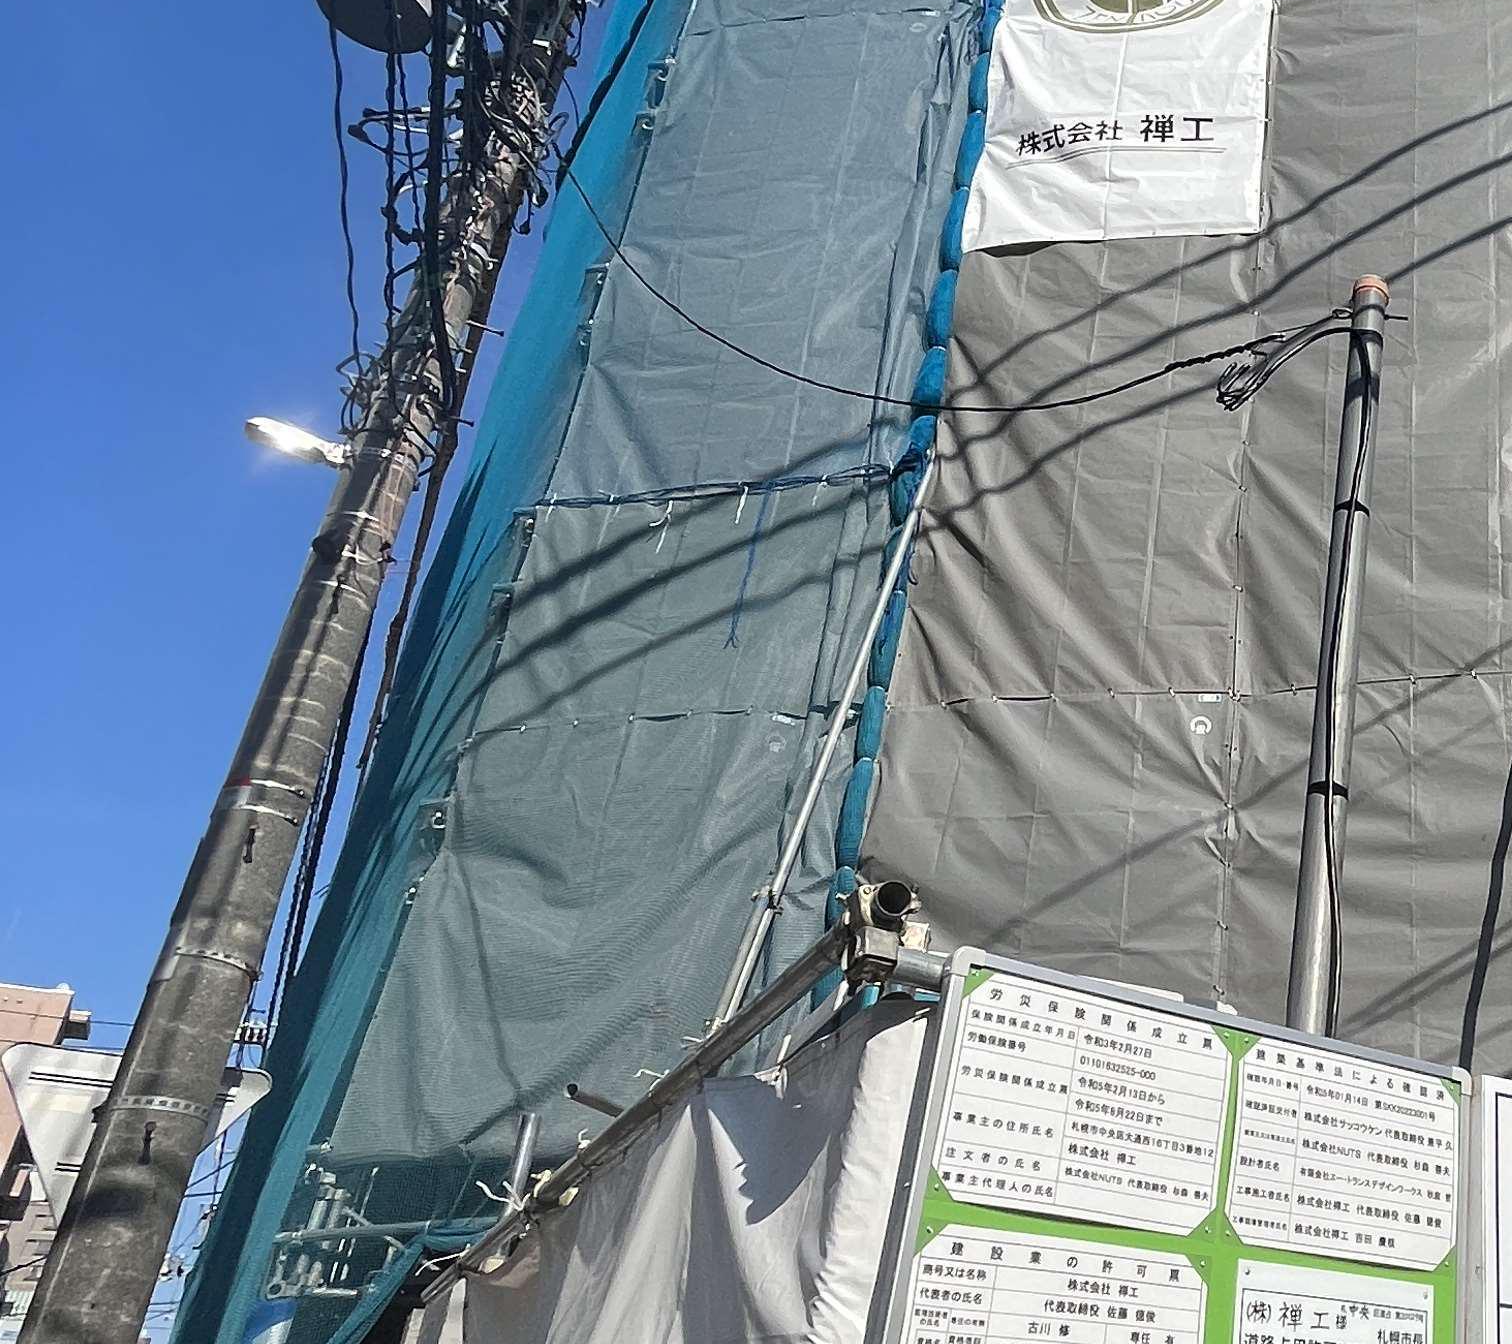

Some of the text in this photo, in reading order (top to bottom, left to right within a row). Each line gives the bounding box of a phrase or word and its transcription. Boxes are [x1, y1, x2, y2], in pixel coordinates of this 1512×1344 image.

[1015, 114, 1216, 156] 株式会社 禅工
[1083, 1033, 1153, 1060] 令和3年2月27日
[1067, 1142, 1110, 1162] 株式会社
[950, 1240, 1182, 1284] 建設業の許可票
[922, 1263, 988, 1283] 商号又は名称
[919, 1286, 984, 1306] 代表者の氏名
[1067, 1277, 1112, 1297] 株式会社
[1043, 1298, 1101, 1318] 代表取締役
[1130, 1330, 1151, 1344] 専任
